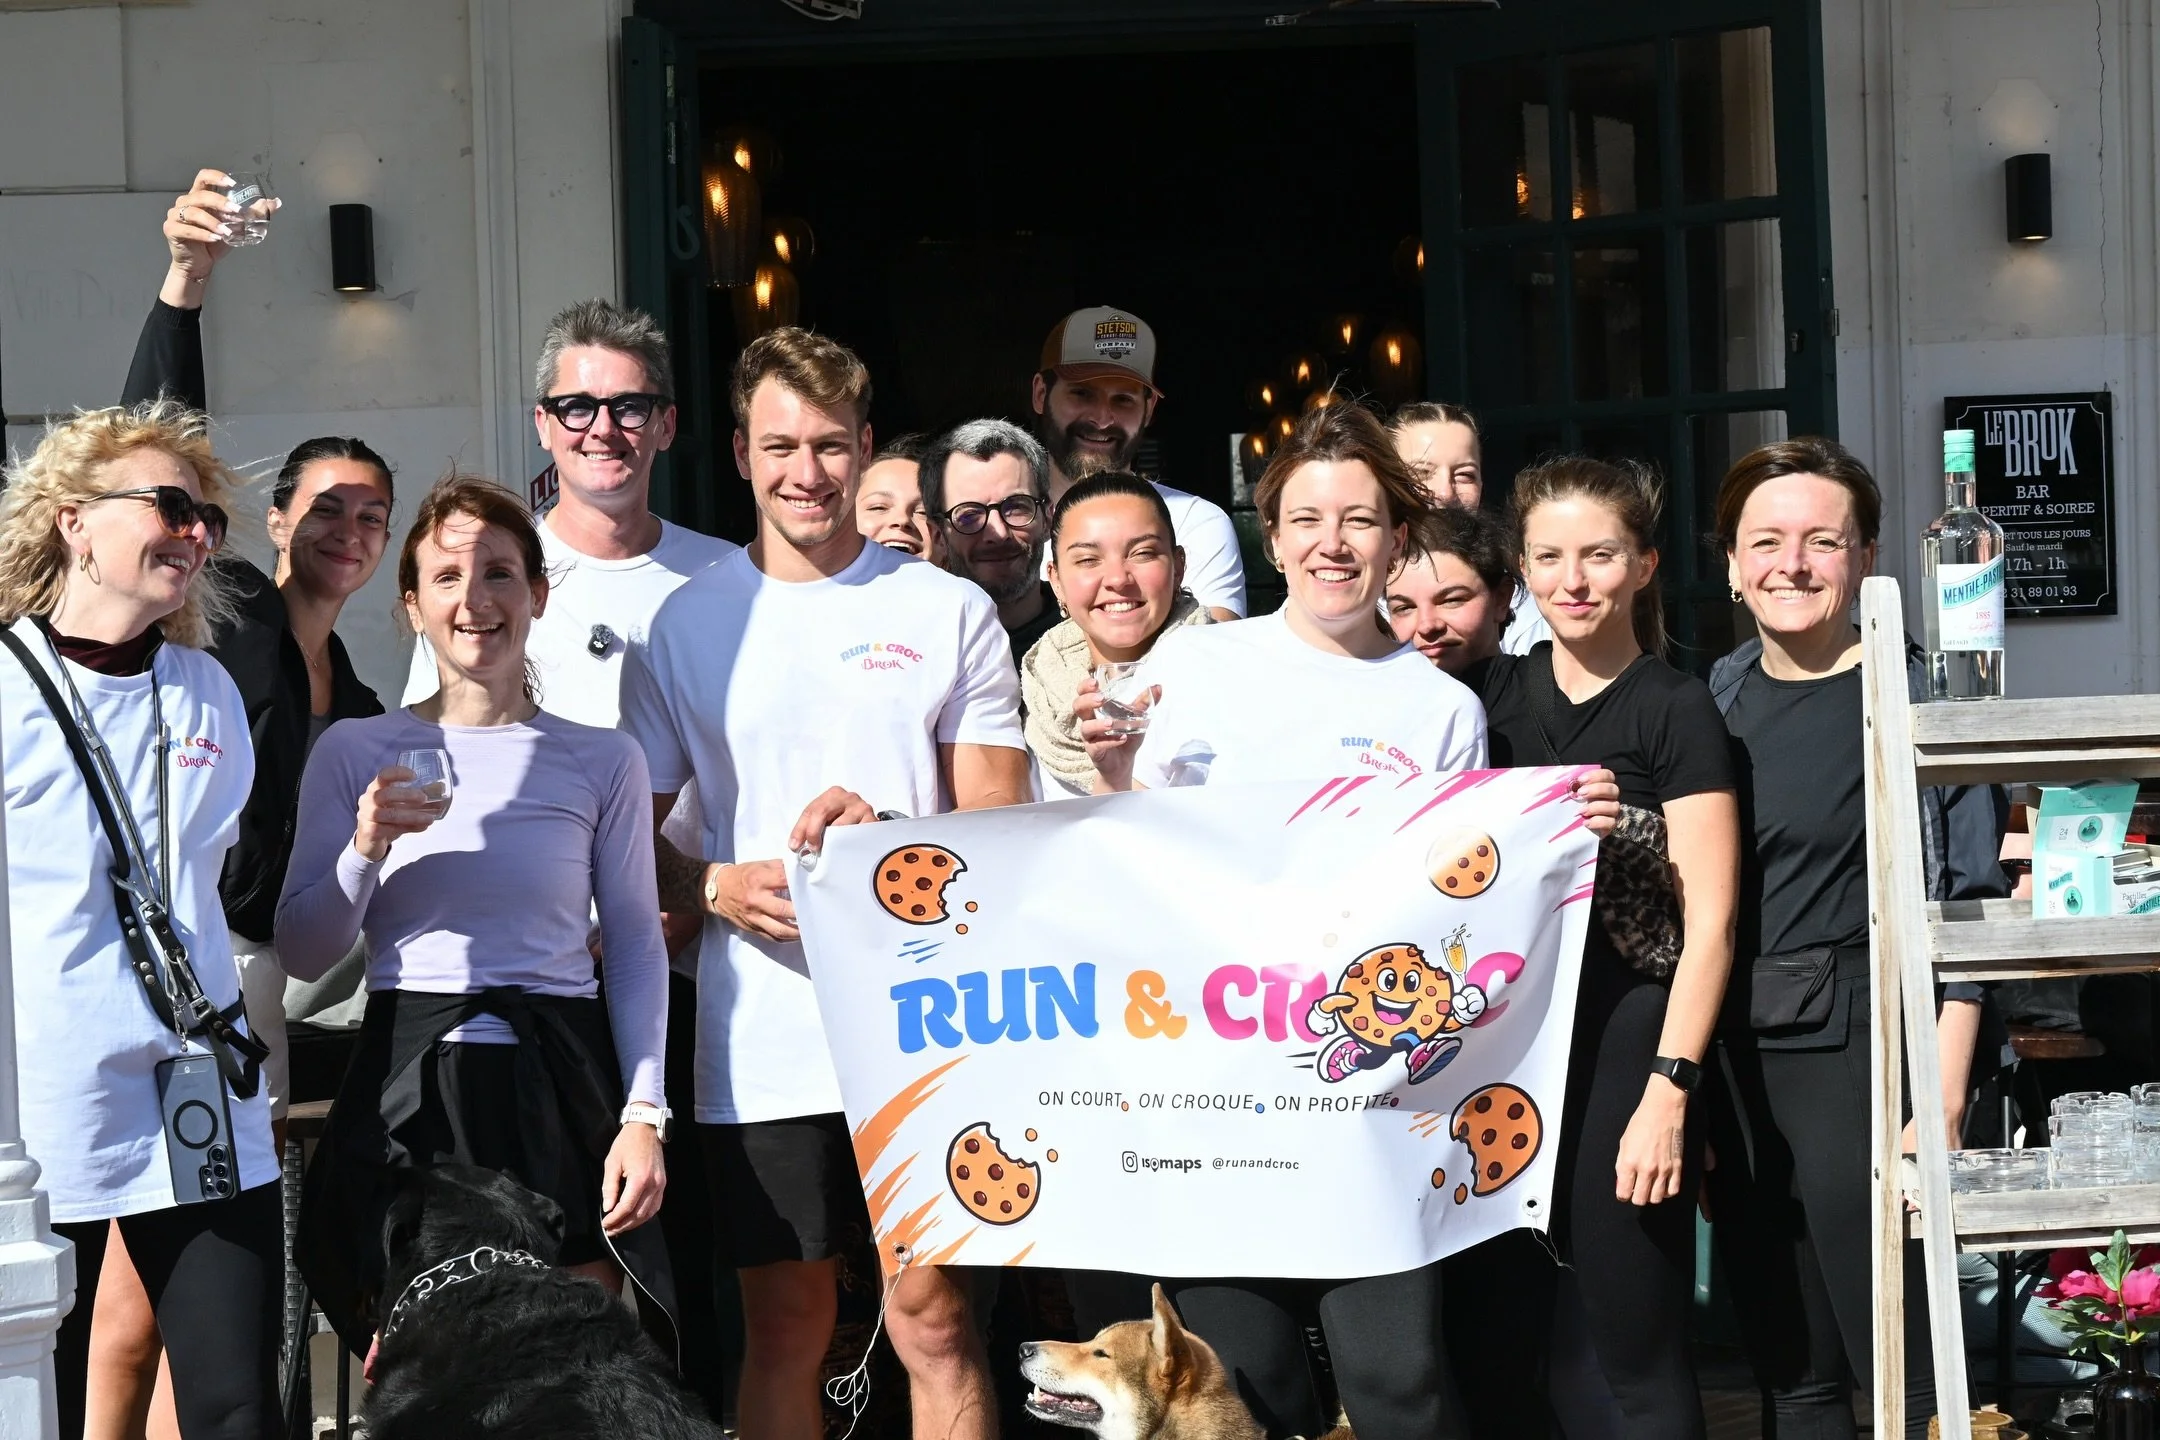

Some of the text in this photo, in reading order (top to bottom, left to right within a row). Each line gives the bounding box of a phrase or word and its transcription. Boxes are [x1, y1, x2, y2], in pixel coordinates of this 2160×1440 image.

[1097, 322, 1136, 334] STETSON
[1984, 408, 2078, 477] LE BROK
[2016, 485, 2050, 499] BAR
[1980, 503, 2095, 517] PERITIF & SOIREE
[2017, 531, 2042, 540] TOUS
[2044, 531, 2061, 539] LES
[2062, 529, 2092, 540] JOURS
[2005, 541, 2063, 552] Sauf le mardi
[2005, 557, 2033, 571] 17h
[2048, 556, 2067, 570] 1h
[2011, 587, 2024, 598] 31
[2028, 587, 2042, 598] 89
[2045, 586, 2059, 597] 01
[2063, 585, 2077, 596] 93
[840, 643, 923, 662] RUN & CROC
[185, 736, 193, 747] &
[196, 737, 223, 760] CROC
[1340, 737, 1422, 773] RUN & CROC
[2059, 827, 2069, 836] 24
[890, 952, 1526, 1054] RUN & CRC
[1038, 1091, 1064, 1106] ON
[1139, 1094, 1165, 1109] ON
[1274, 1095, 1301, 1111] ON
[1212, 1157, 1300, 1170] @runandcroc
